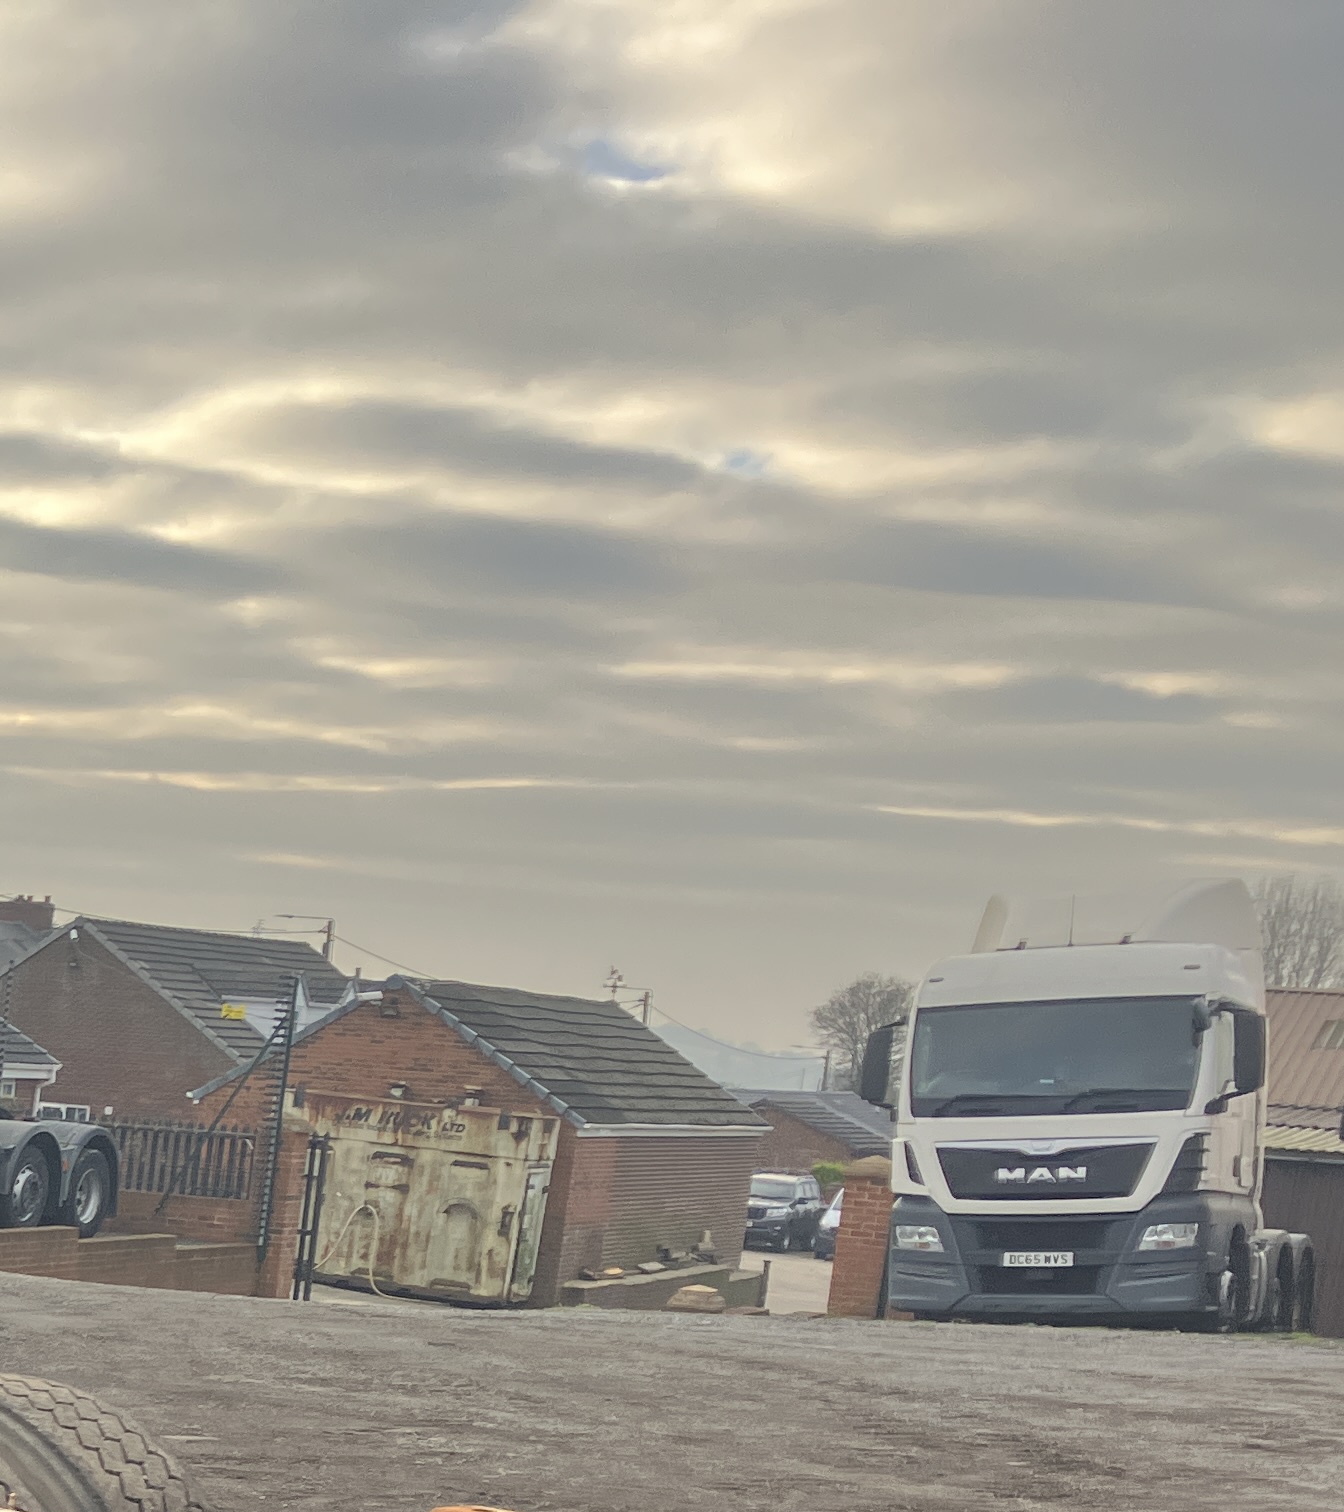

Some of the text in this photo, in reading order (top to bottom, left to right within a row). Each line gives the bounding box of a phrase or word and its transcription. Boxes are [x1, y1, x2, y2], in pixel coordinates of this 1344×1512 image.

[441, 1122, 466, 1134] LTD
[995, 1166, 1087, 1184] MAN
[1009, 1254, 1041, 1265] DC65
